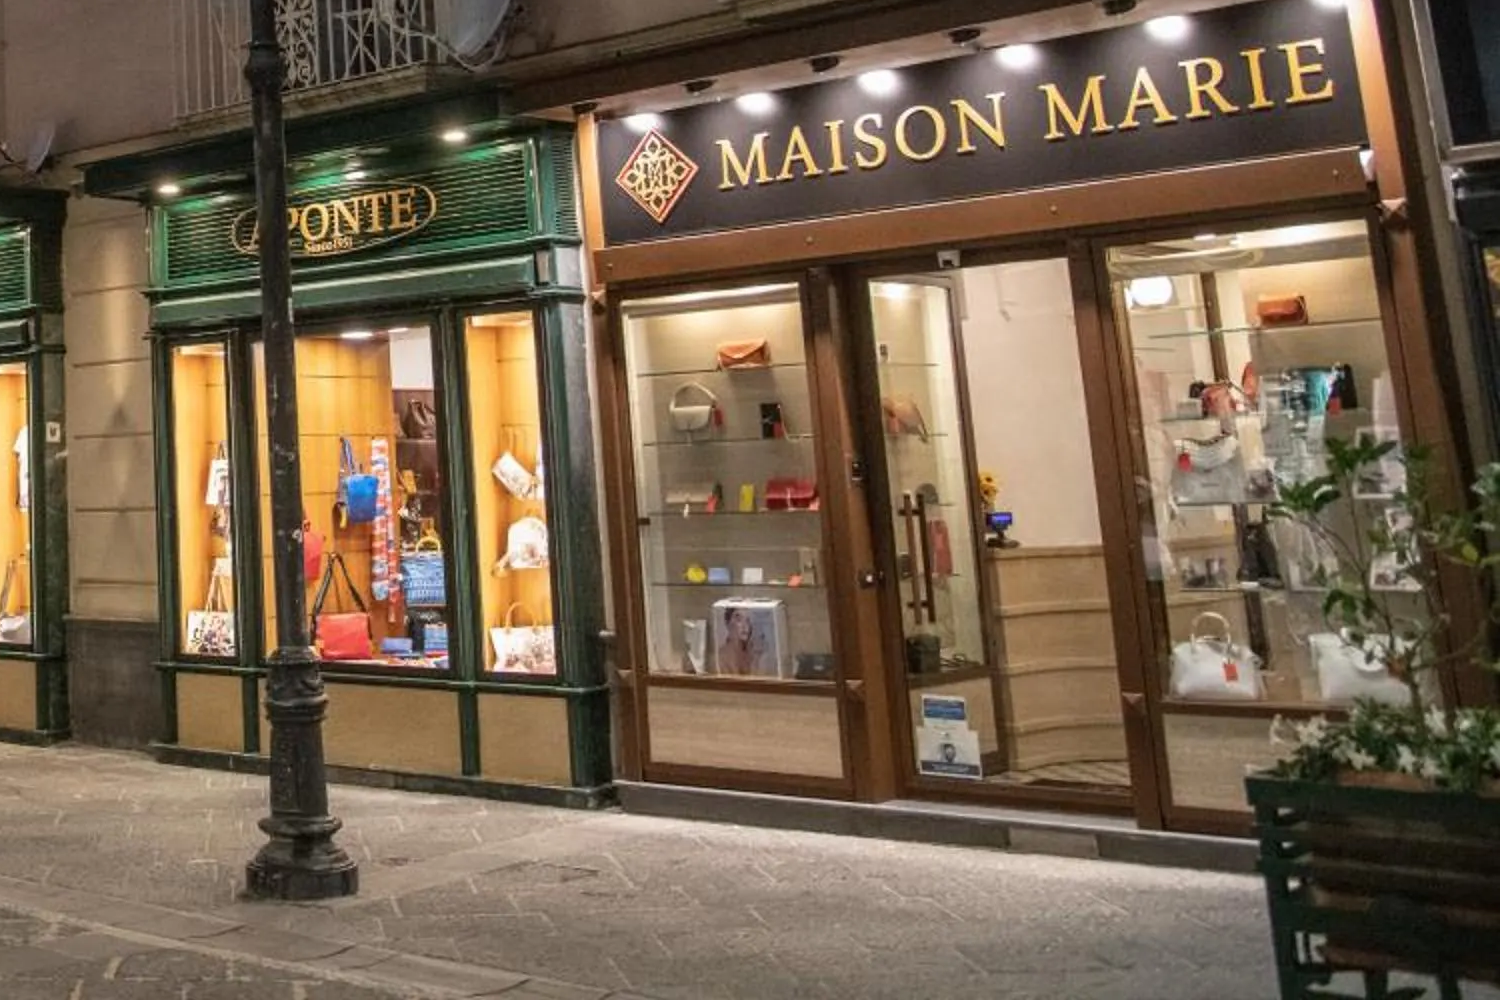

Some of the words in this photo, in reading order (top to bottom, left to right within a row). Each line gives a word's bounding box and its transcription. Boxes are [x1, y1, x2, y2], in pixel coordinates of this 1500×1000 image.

[716, 92, 1006, 191] MAISON
[1038, 37, 1334, 141] MARIE
[246, 186, 418, 251] PONTE
